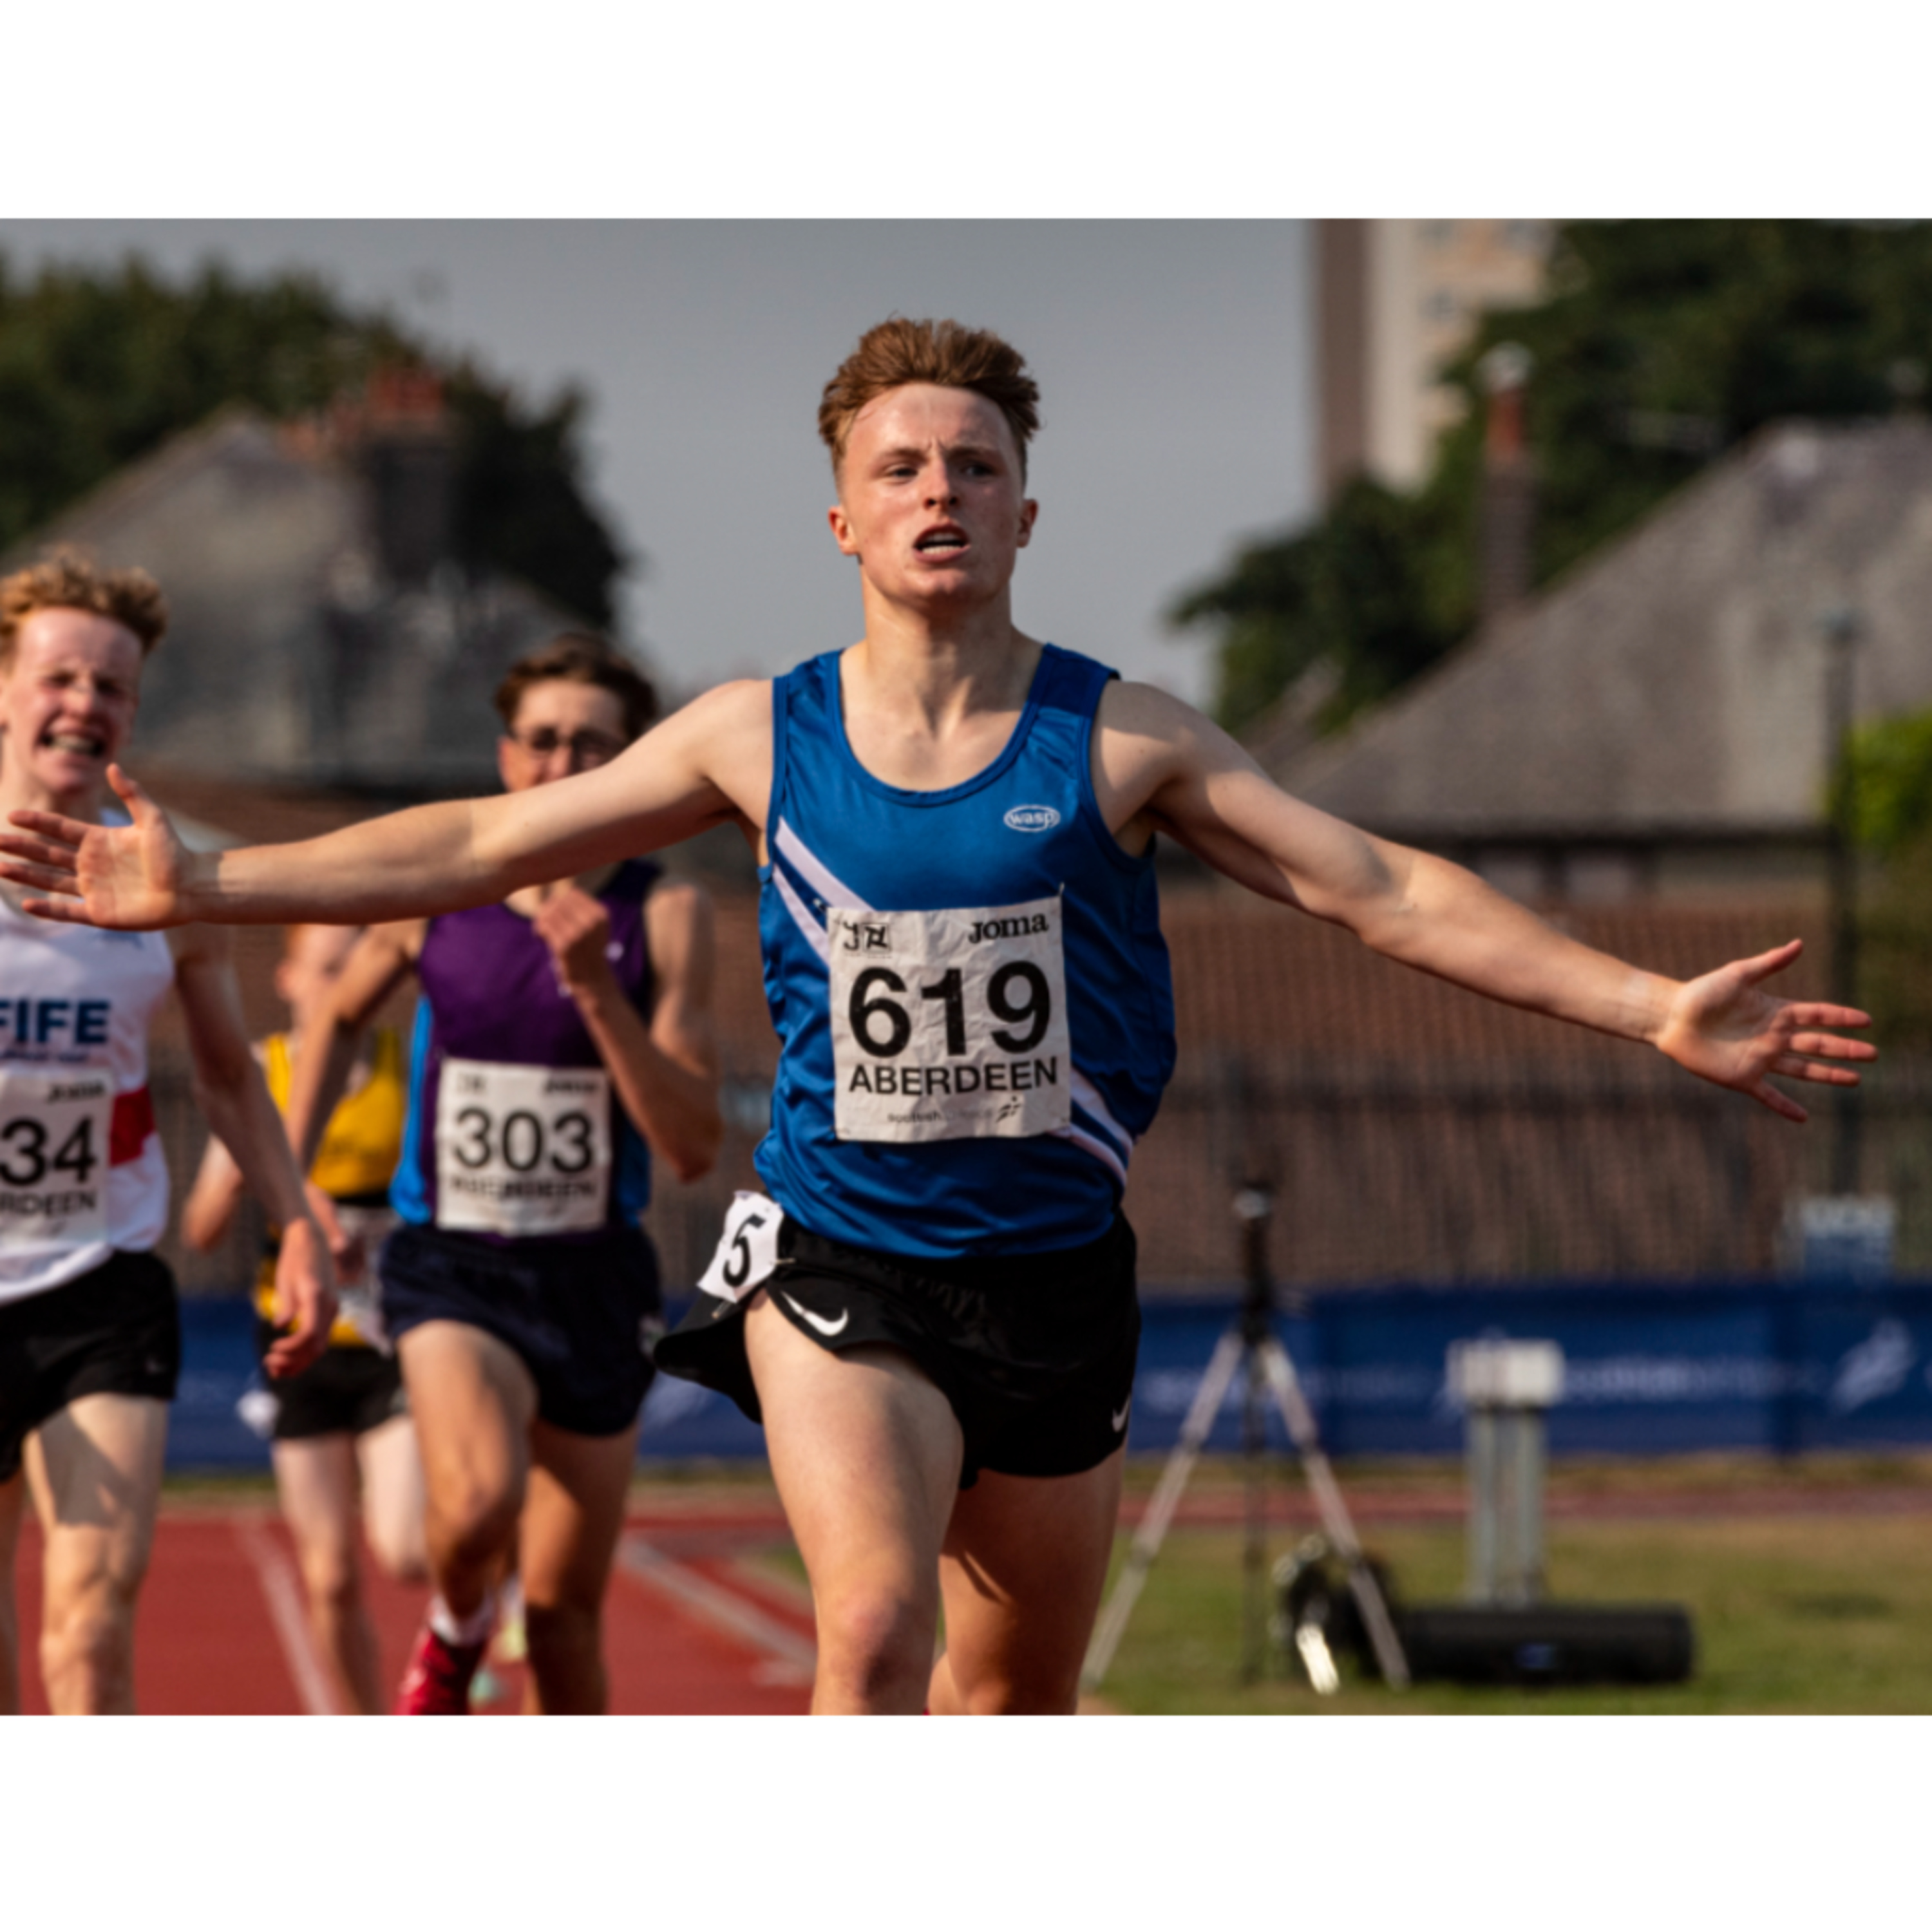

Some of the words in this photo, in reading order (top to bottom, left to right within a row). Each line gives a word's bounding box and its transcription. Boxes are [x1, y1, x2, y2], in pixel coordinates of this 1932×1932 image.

[1010, 812, 1056, 829] wasp
[969, 913, 1048, 943] Joma
[848, 960, 1052, 1059] 619
[848, 1056, 1058, 1095] ABERDEEN
[0, 1116, 97, 1186] 34
[455, 1106, 592, 1174] 303
[723, 1212, 766, 1288] 5
